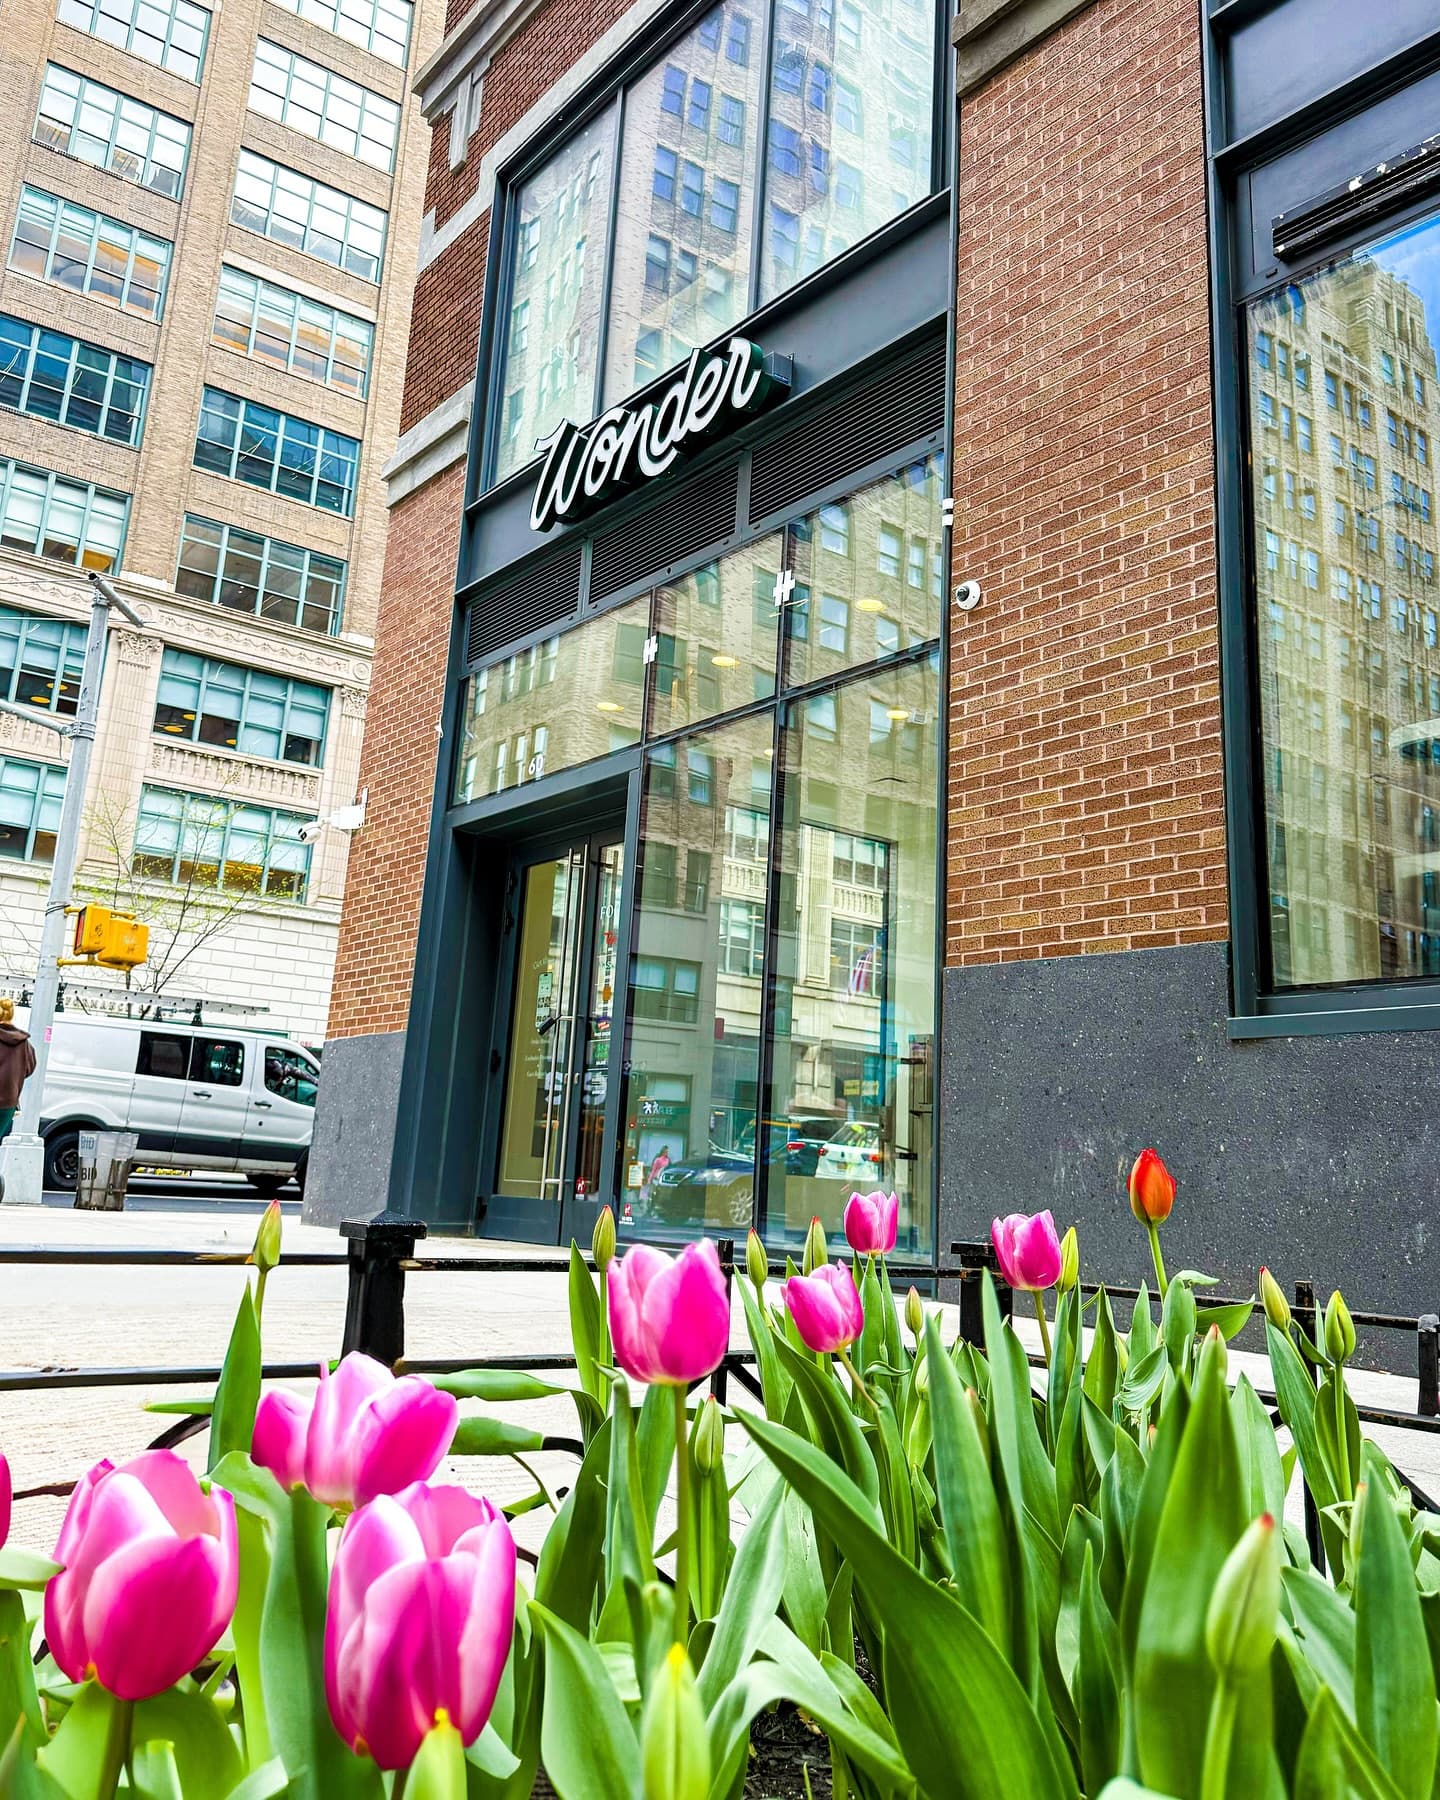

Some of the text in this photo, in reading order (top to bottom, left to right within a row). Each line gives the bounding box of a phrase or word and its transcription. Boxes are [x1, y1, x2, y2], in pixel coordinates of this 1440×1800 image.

[529, 337, 761, 531] Wonder
[528, 754, 543, 775] 60
[80, 1135, 95, 1150] BID
[80, 1167, 98, 1181] BID
